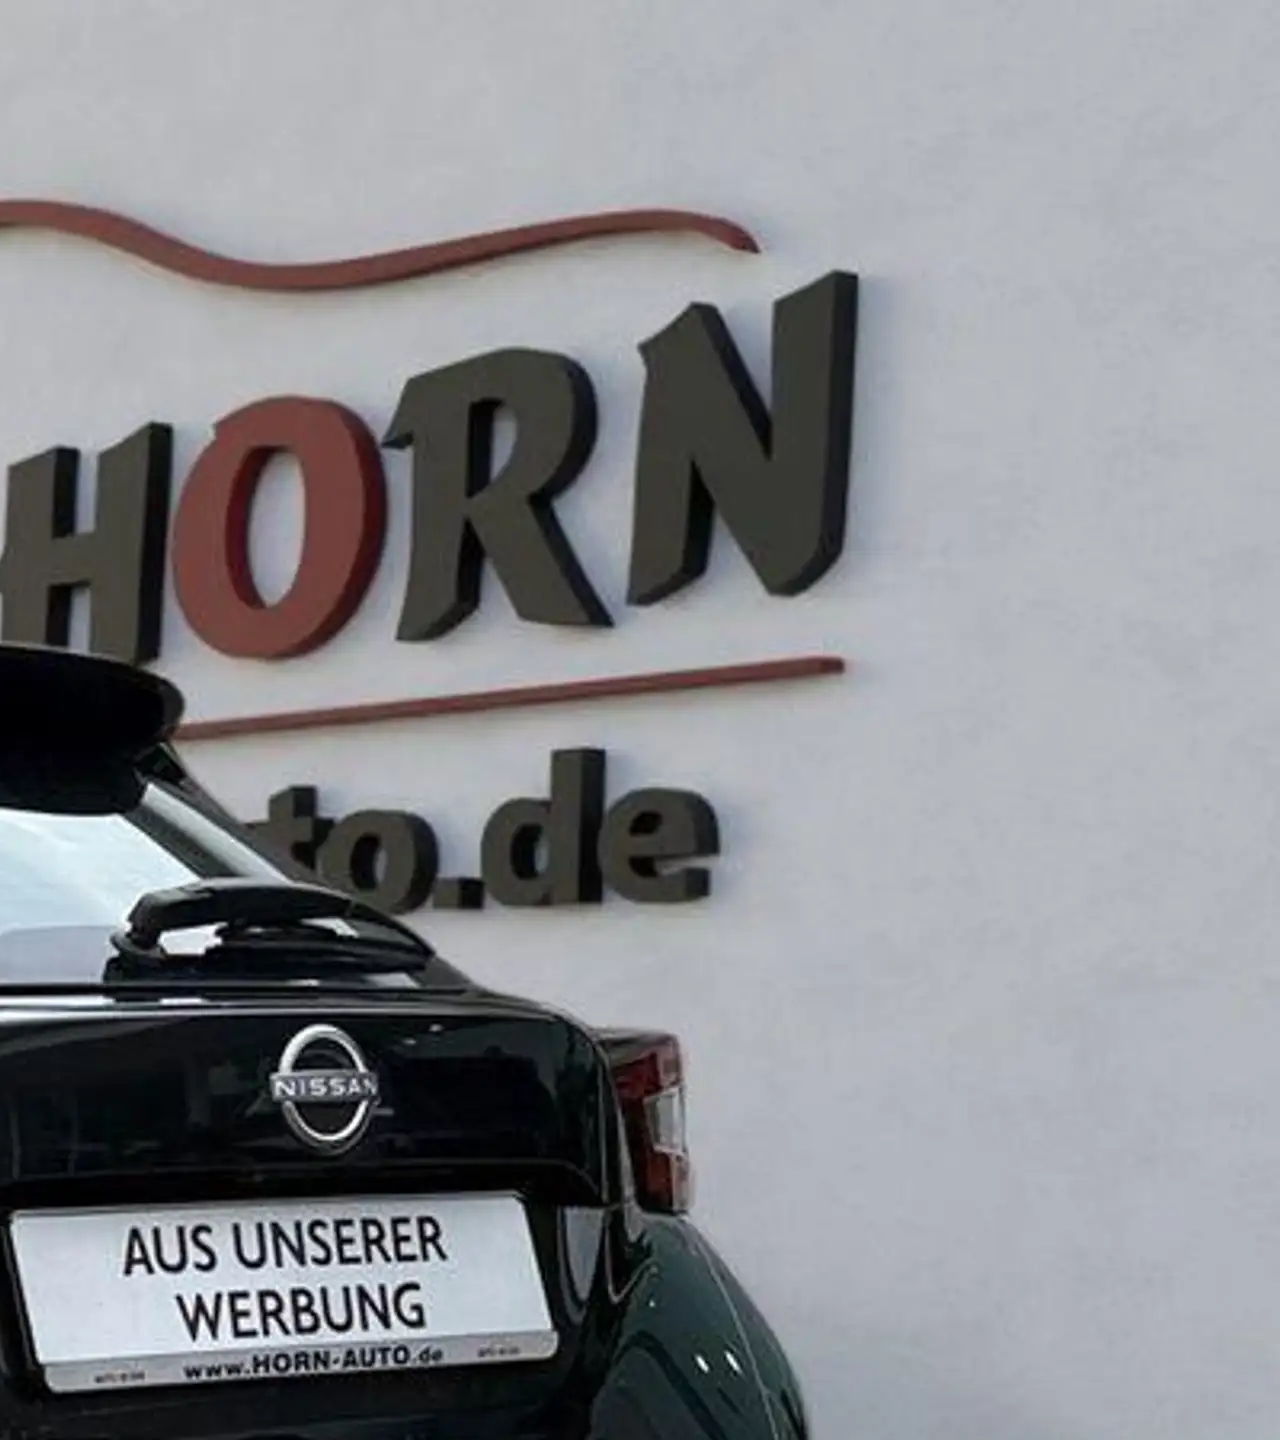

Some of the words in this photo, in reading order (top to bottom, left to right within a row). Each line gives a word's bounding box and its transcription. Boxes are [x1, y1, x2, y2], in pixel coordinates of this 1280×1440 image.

[274, 1076, 379, 1097] NISSAN
[122, 1225, 216, 1276] AUS
[231, 1215, 448, 1270] UNSERER
[175, 1282, 427, 1343] WERBUNG
[183, 1344, 444, 1382] www.HORN-AUTO.de
